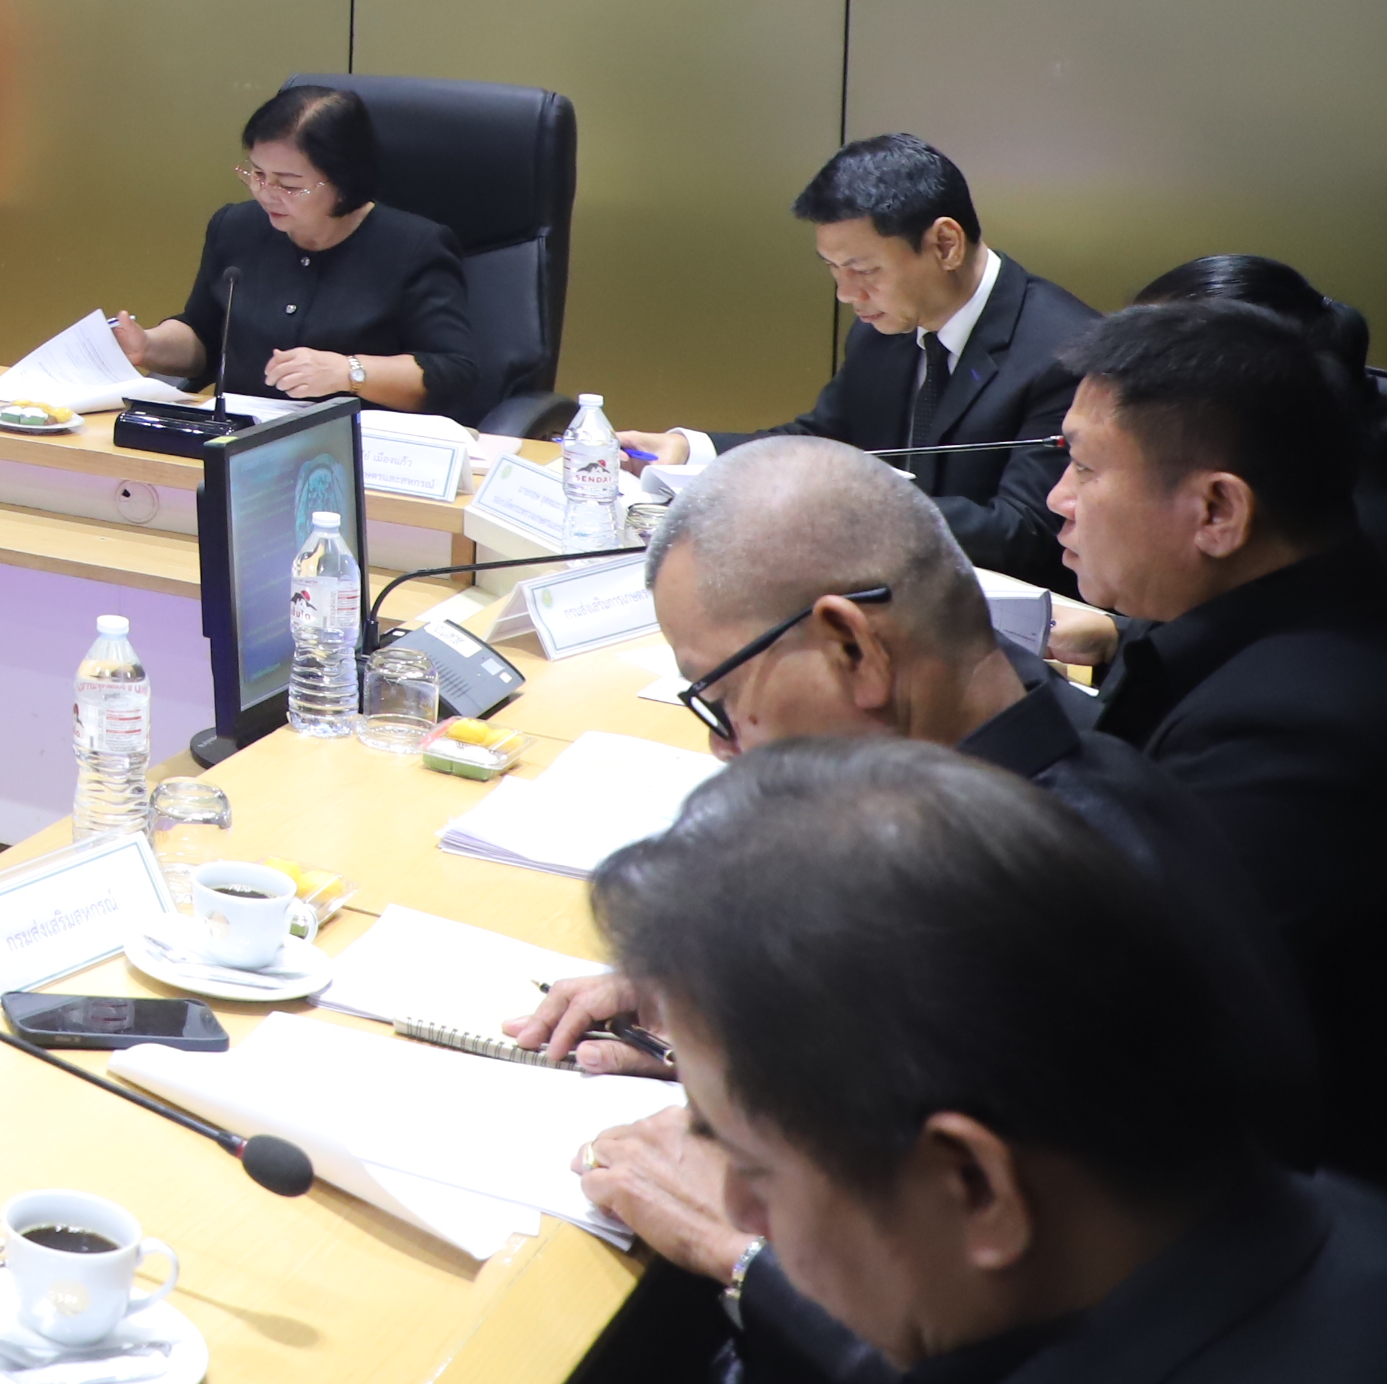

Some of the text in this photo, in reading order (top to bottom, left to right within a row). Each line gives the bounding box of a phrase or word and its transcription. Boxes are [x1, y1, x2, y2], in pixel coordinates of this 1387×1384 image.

[575, 475, 612, 484] SENDAI
[5, 888, 120, 952] กรมส่งเสริมสหกรณ์
